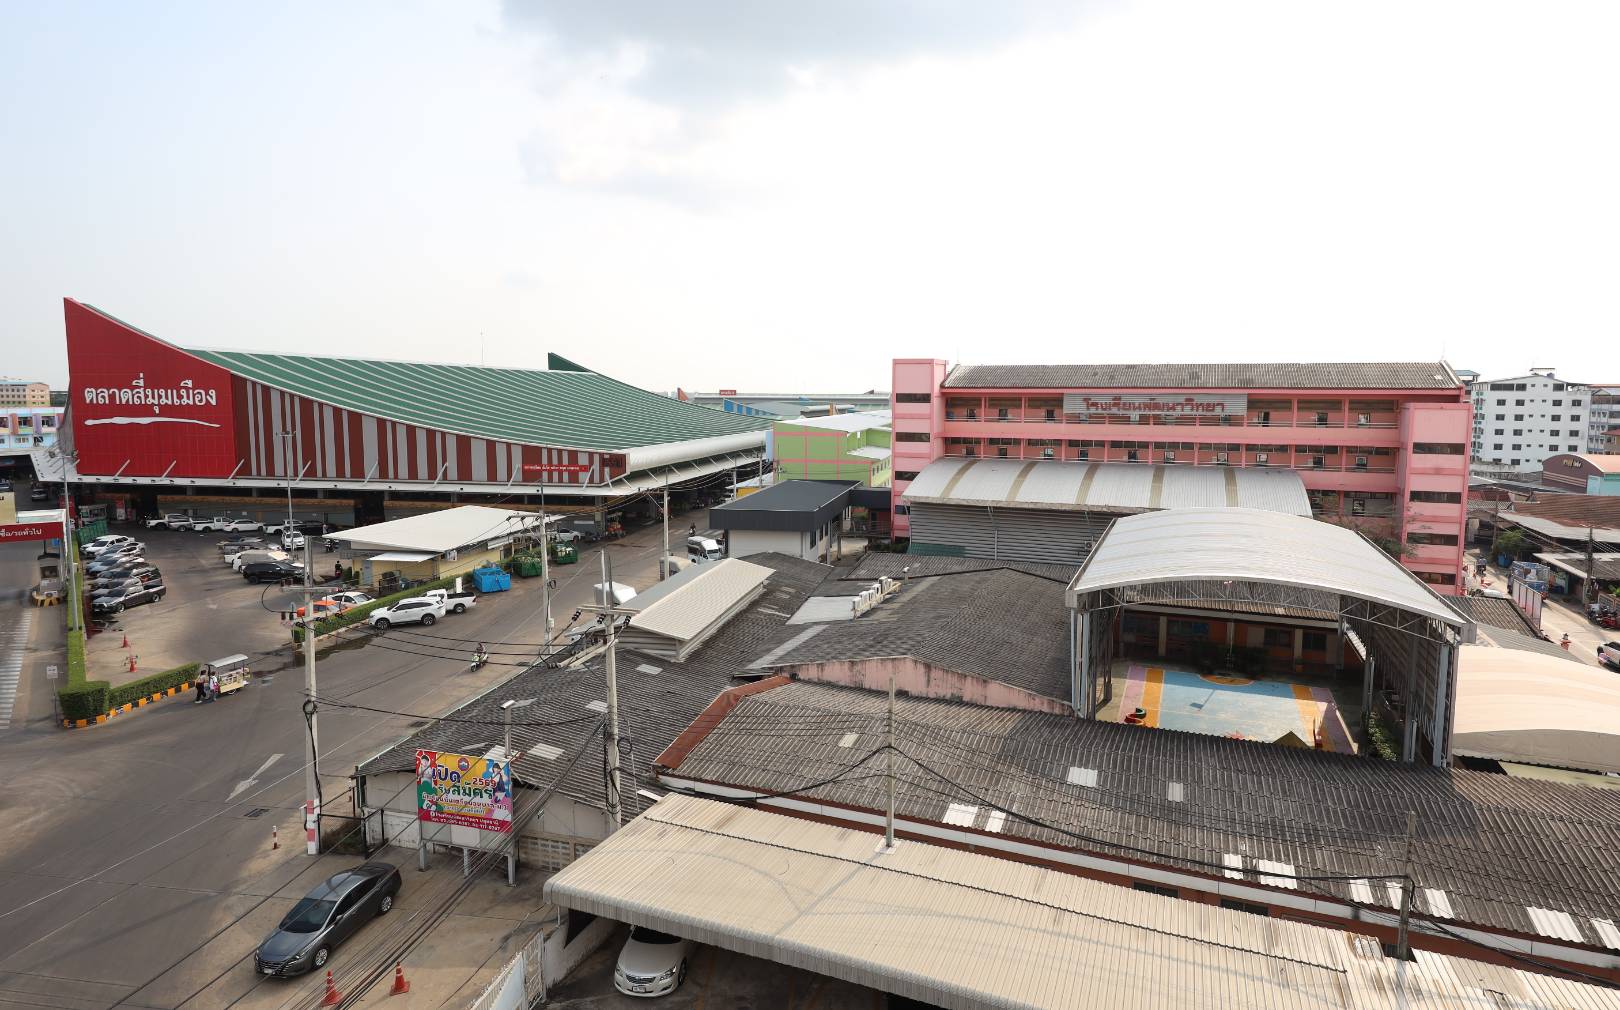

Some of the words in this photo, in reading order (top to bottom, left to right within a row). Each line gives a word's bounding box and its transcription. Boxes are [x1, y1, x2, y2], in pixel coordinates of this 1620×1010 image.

[84, 372, 217, 414] ตลาดสี่มุมเมือง
[432, 764, 461, 783] เปิด
